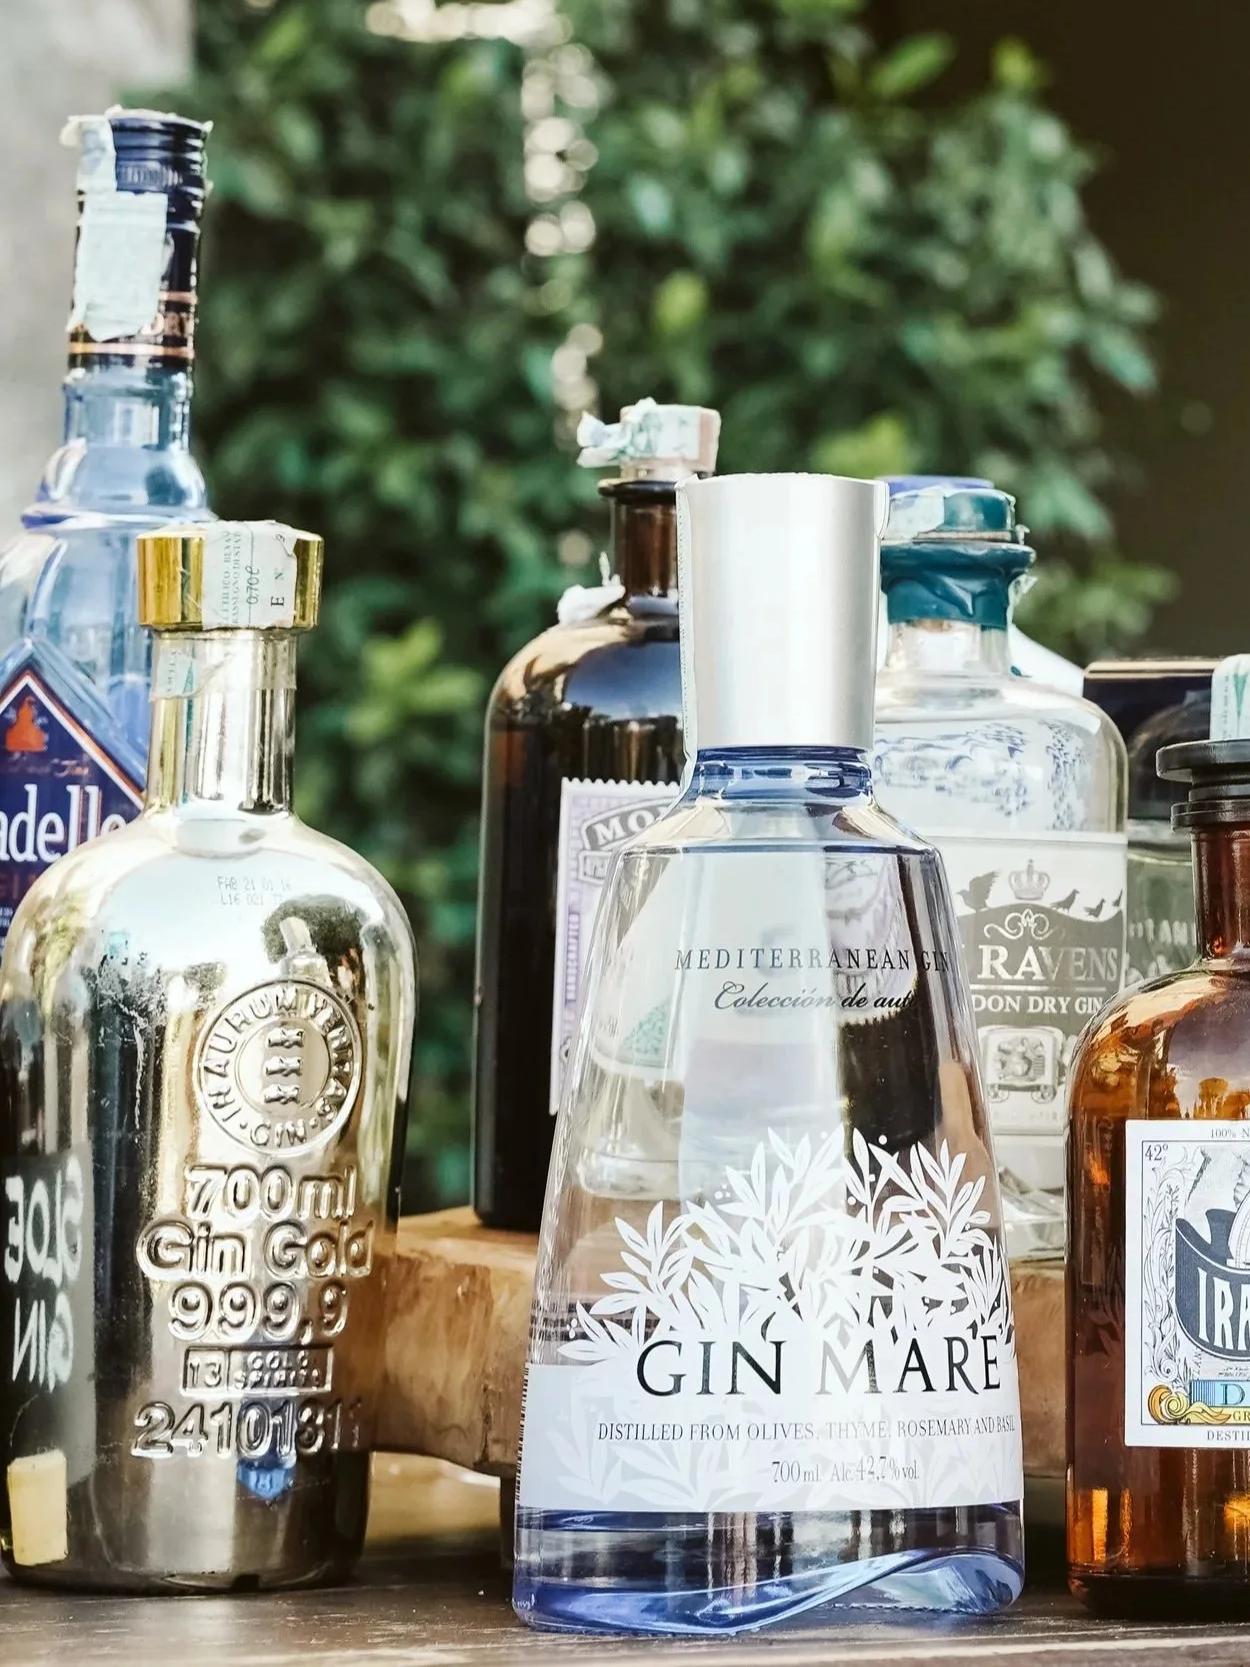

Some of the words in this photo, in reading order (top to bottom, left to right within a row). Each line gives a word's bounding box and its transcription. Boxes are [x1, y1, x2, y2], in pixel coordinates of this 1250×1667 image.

[593, 804, 662, 847] MO
[674, 947, 911, 971] MEDITERRANEAN
[920, 950, 950, 973] GIN
[977, 944, 1118, 983] RAVENS
[713, 980, 836, 1010] Colección
[841, 982, 868, 1009] de
[1028, 996, 1071, 1015] DRY
[1074, 996, 1103, 1015] GIN
[1211, 1128, 1237, 1139] 100%
[1145, 1144, 1169, 1162] 42°
[184, 1164, 358, 1221] 700ml
[136, 1220, 251, 1281] Gin
[263, 1218, 374, 1279] Gold
[168, 1282, 349, 1345] 999,9
[636, 1339, 787, 1397] GIN
[815, 1334, 1001, 1395] MARE
[598, 1422, 683, 1441] DISTILLED
[690, 1422, 740, 1441] FROM
[897, 1417, 972, 1438] ROSEMARY
[974, 1415, 995, 1435] AND
[996, 1414, 1016, 1434] BASIL
[772, 1460, 801, 1483] 700
